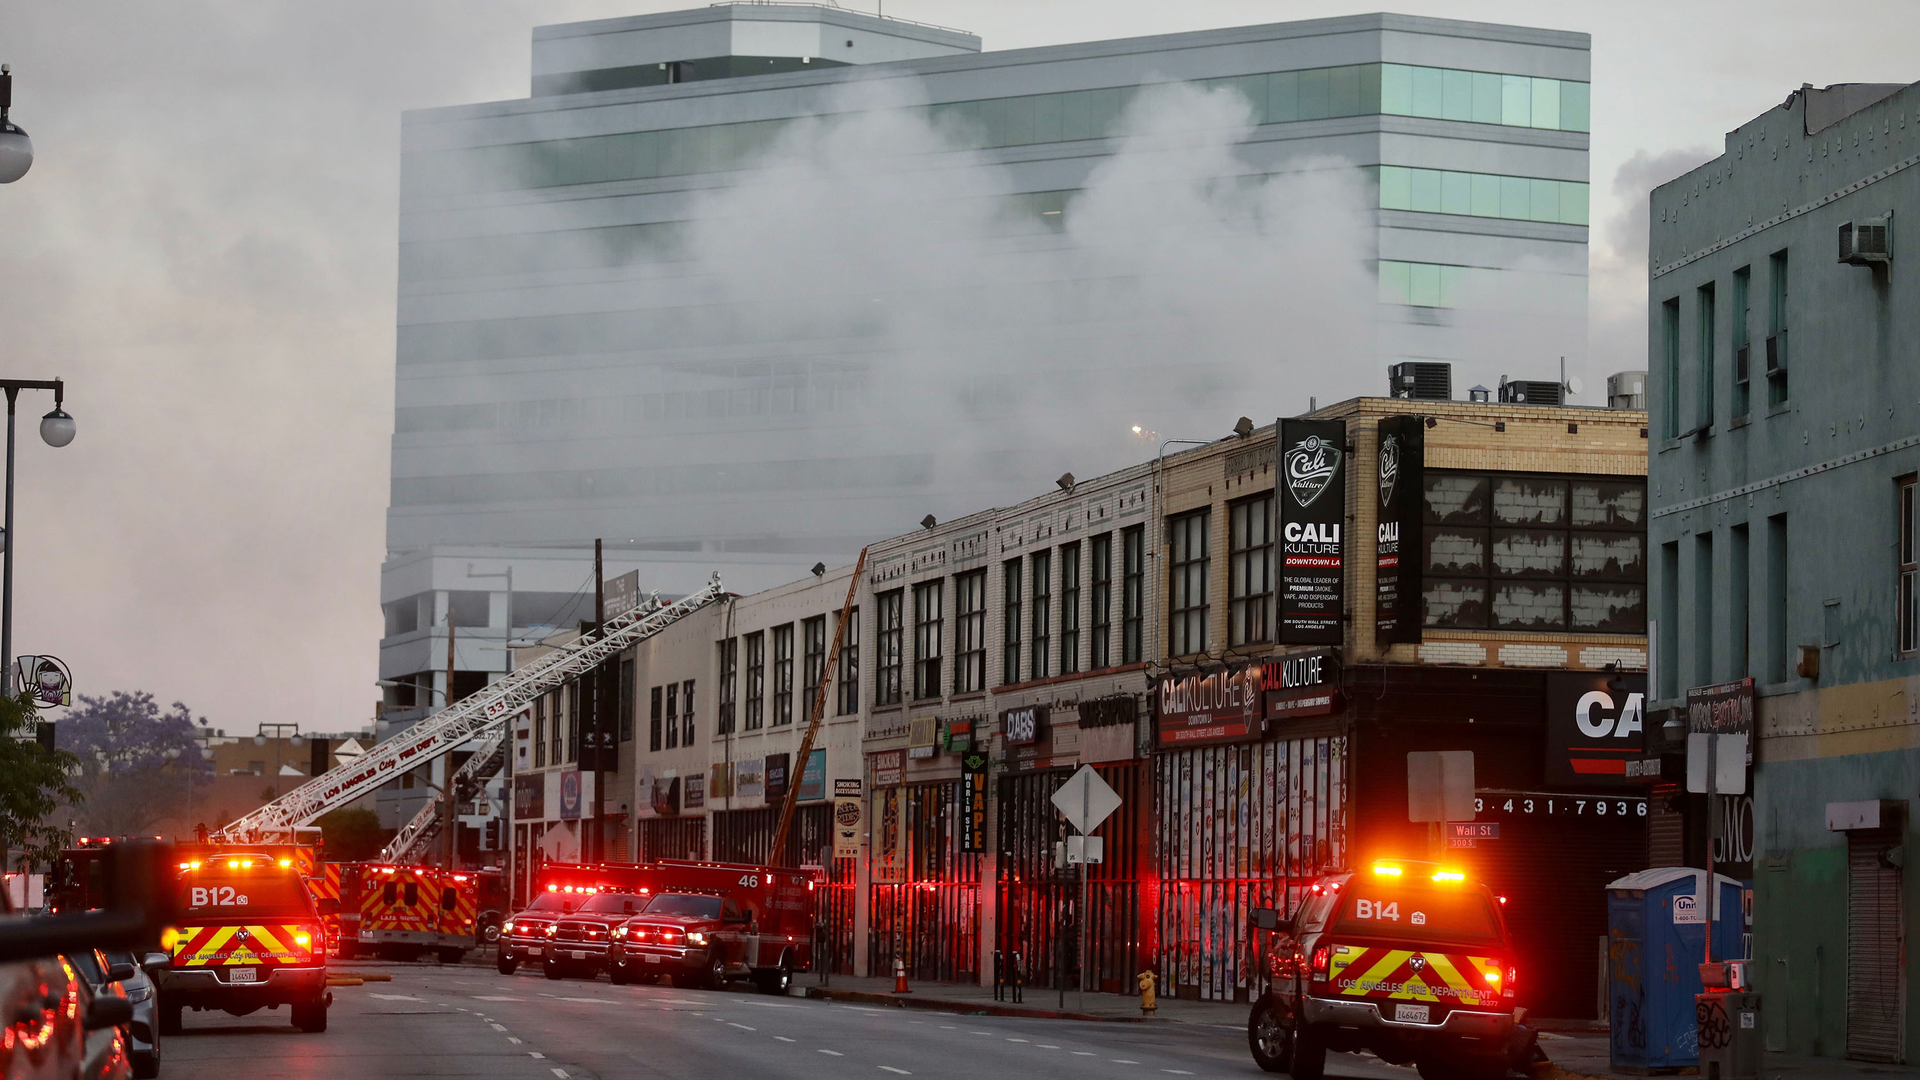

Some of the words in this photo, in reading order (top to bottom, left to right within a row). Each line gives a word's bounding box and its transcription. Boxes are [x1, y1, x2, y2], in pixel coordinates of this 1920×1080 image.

[1290, 448, 1326, 478] Cali
[1292, 480, 1323, 488] Kulture
[1284, 522, 1340, 542] CALI
[1378, 522, 1398, 543] CALI
[1284, 544, 1339, 554] KULTURE
[1378, 542, 1398, 553] KULTURE
[488, 701, 504, 715] 33
[1007, 709, 1034, 740] DABS
[324, 786, 340, 800] LOS
[341, 767, 377, 791] ANGELES
[379, 758, 396, 771] City
[399, 750, 417, 761] FIRE
[416, 736, 439, 751] DEPT.
[877, 752, 900, 770] SMOKING
[973, 773, 984, 848] VAPE
[1456, 826, 1476, 836] Wall
[1480, 826, 1491, 836] St
[367, 880, 377, 890] 11
[738, 875, 758, 888] 46
[192, 886, 235, 906] B12
[1356, 899, 1400, 921] B14
[230, 950, 243, 962] City
[1338, 978, 1357, 989] LOS
[1360, 980, 1403, 993] ANGELES
[1407, 984, 1427, 995] FIRE
[1430, 986, 1491, 1000] DEPARTMENT
[1398, 1010, 1427, 1020] 1464672
